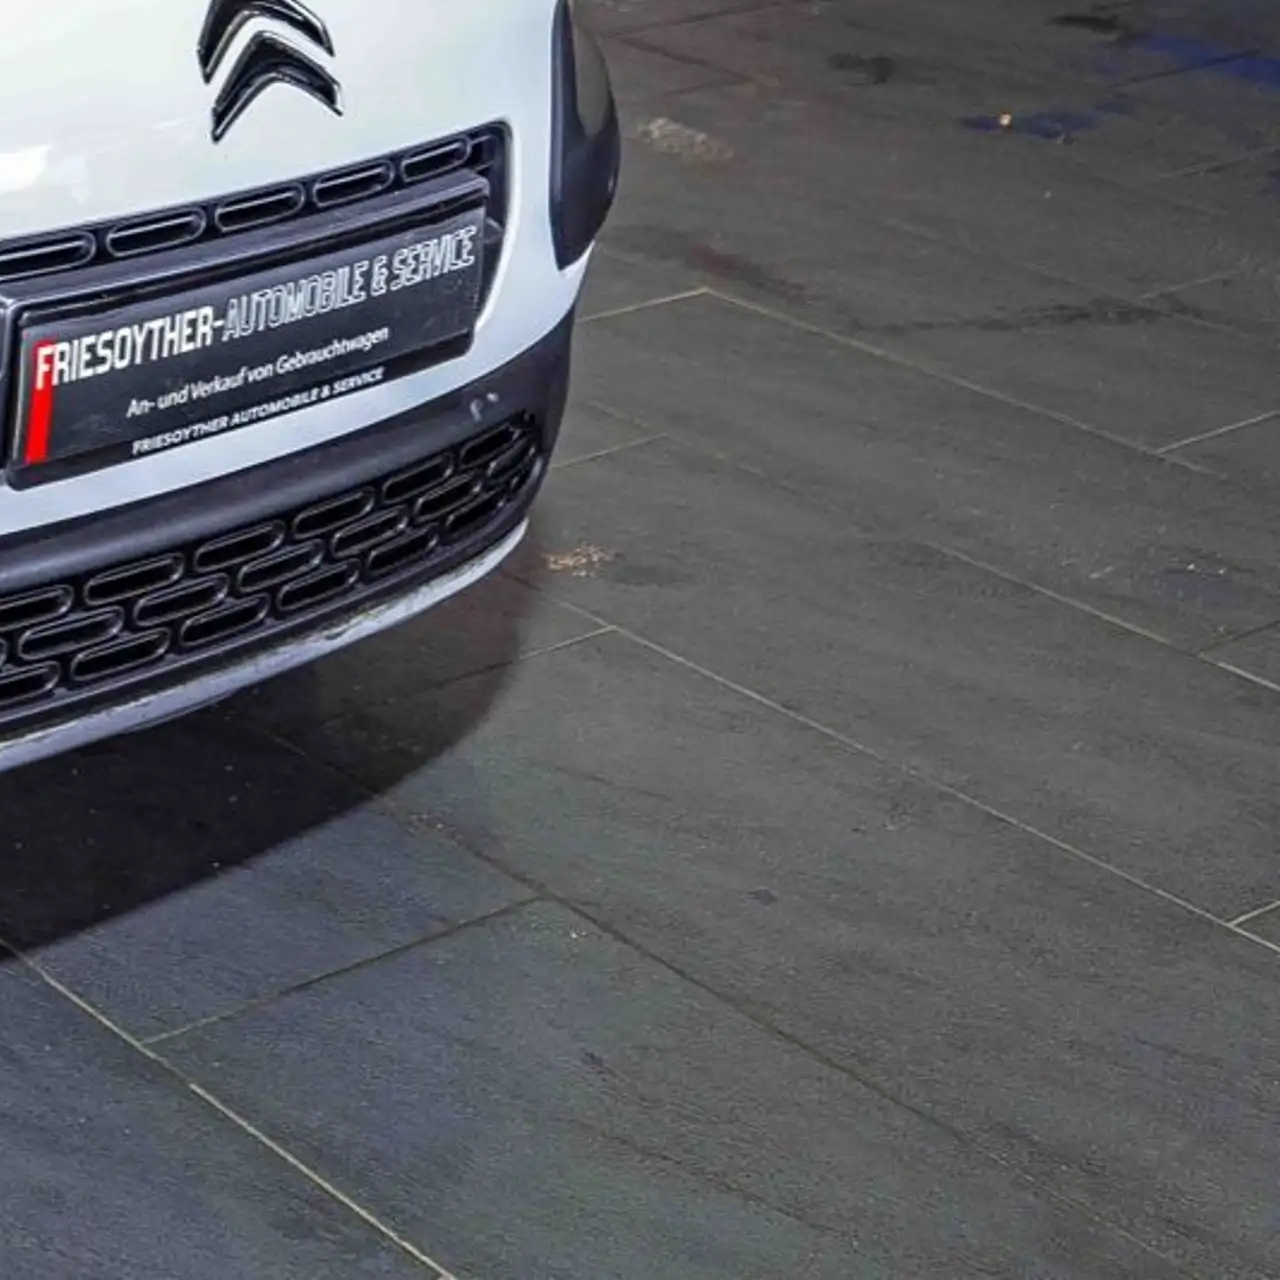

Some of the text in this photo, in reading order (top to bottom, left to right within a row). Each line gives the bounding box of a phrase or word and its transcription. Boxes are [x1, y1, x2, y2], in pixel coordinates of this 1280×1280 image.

[371, 255, 389, 297] &
[389, 225, 477, 291] SERVICE
[157, 384, 189, 409] und
[190, 365, 248, 400] Verkauf
[247, 363, 274, 383] von
[276, 326, 390, 375] Gebrauchtwagen
[132, 416, 229, 455] FRIESOYTHER
[229, 387, 320, 426] AUTOMOBILE
[332, 366, 385, 395] SERVICE
